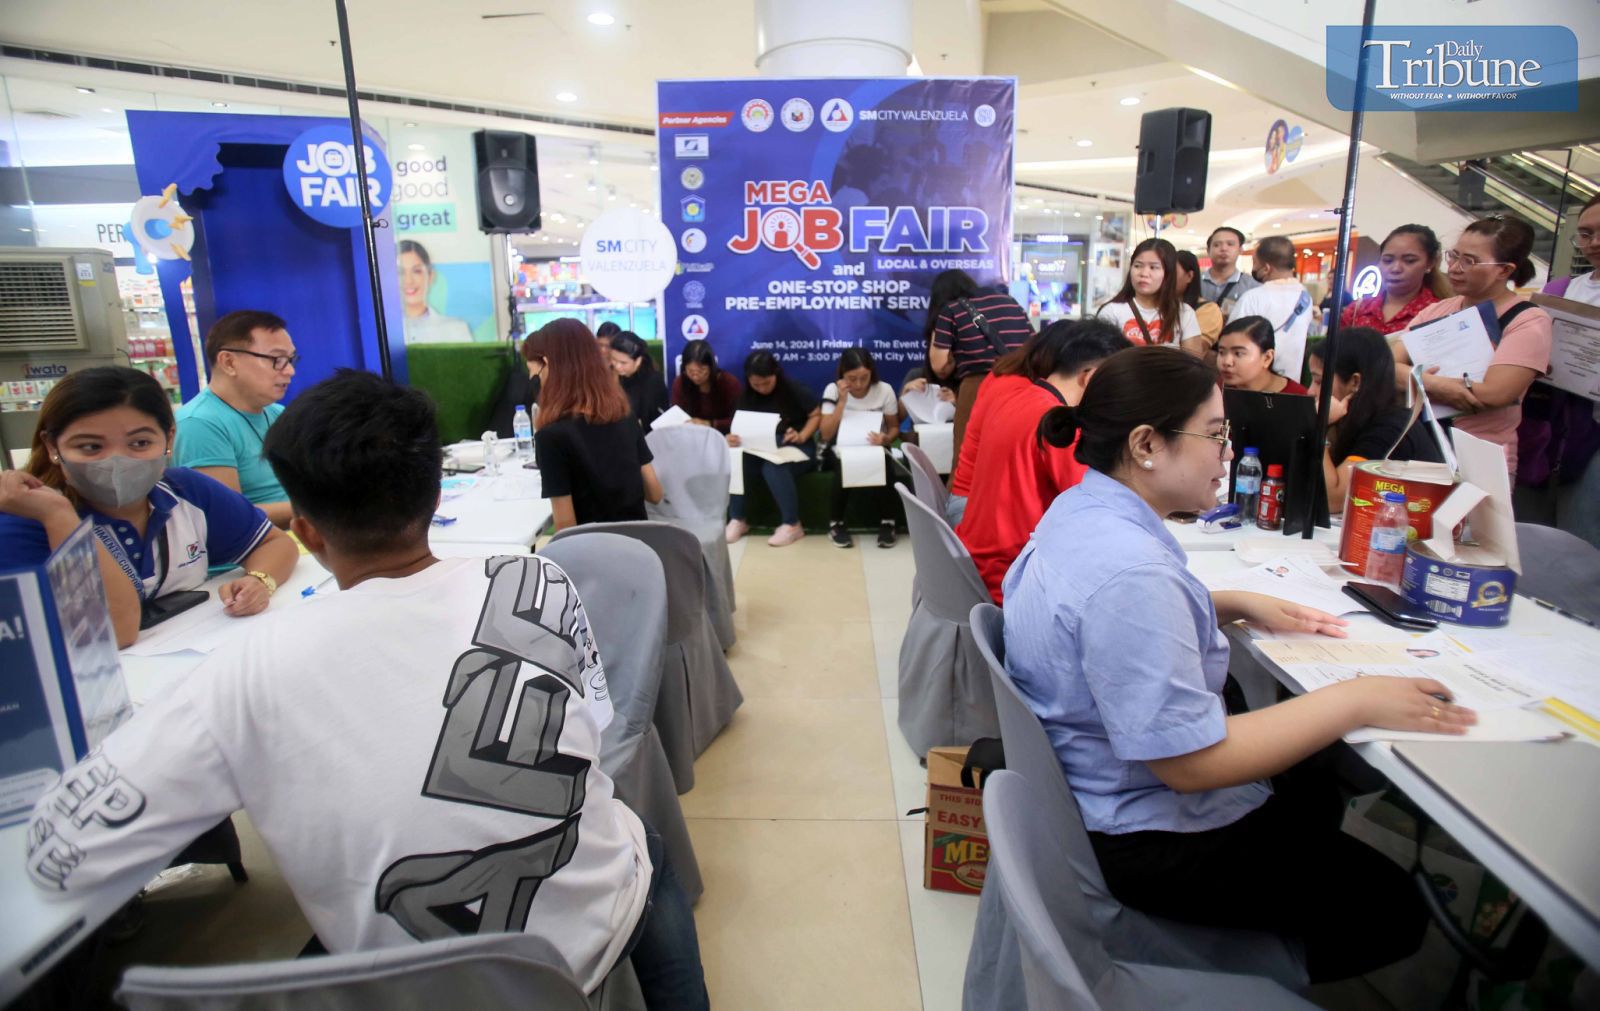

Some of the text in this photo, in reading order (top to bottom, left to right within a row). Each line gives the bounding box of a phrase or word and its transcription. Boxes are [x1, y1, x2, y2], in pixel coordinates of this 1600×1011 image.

[901, 110, 969, 121] VALENZUELA
[397, 155, 447, 176] good
[300, 177, 383, 207] FAIR
[745, 180, 832, 205] MEGA
[397, 209, 450, 231] great
[727, 206, 990, 261] JOB FAIR
[587, 260, 667, 272] VALENZUELA
[833, 262, 865, 276] and
[877, 259, 918, 270] LOCAL
[930, 259, 994, 270] OVERSEAS
[767, 280, 911, 294] ONE-STOP SHOP
[725, 296, 883, 310] PRE-EMPLOYMENT
[751, 340, 774, 349] June
[790, 340, 815, 349] 2024
[873, 340, 890, 349] The
[893, 340, 917, 349] Event
[783, 353, 799, 361] AM
[808, 353, 830, 361] 3:00
[885, 352, 904, 362] City
[1375, 481, 1405, 494] MEGA
[939, 794, 962, 804] THIS
[937, 811, 982, 828] EASY
[944, 840, 992, 864] ME
